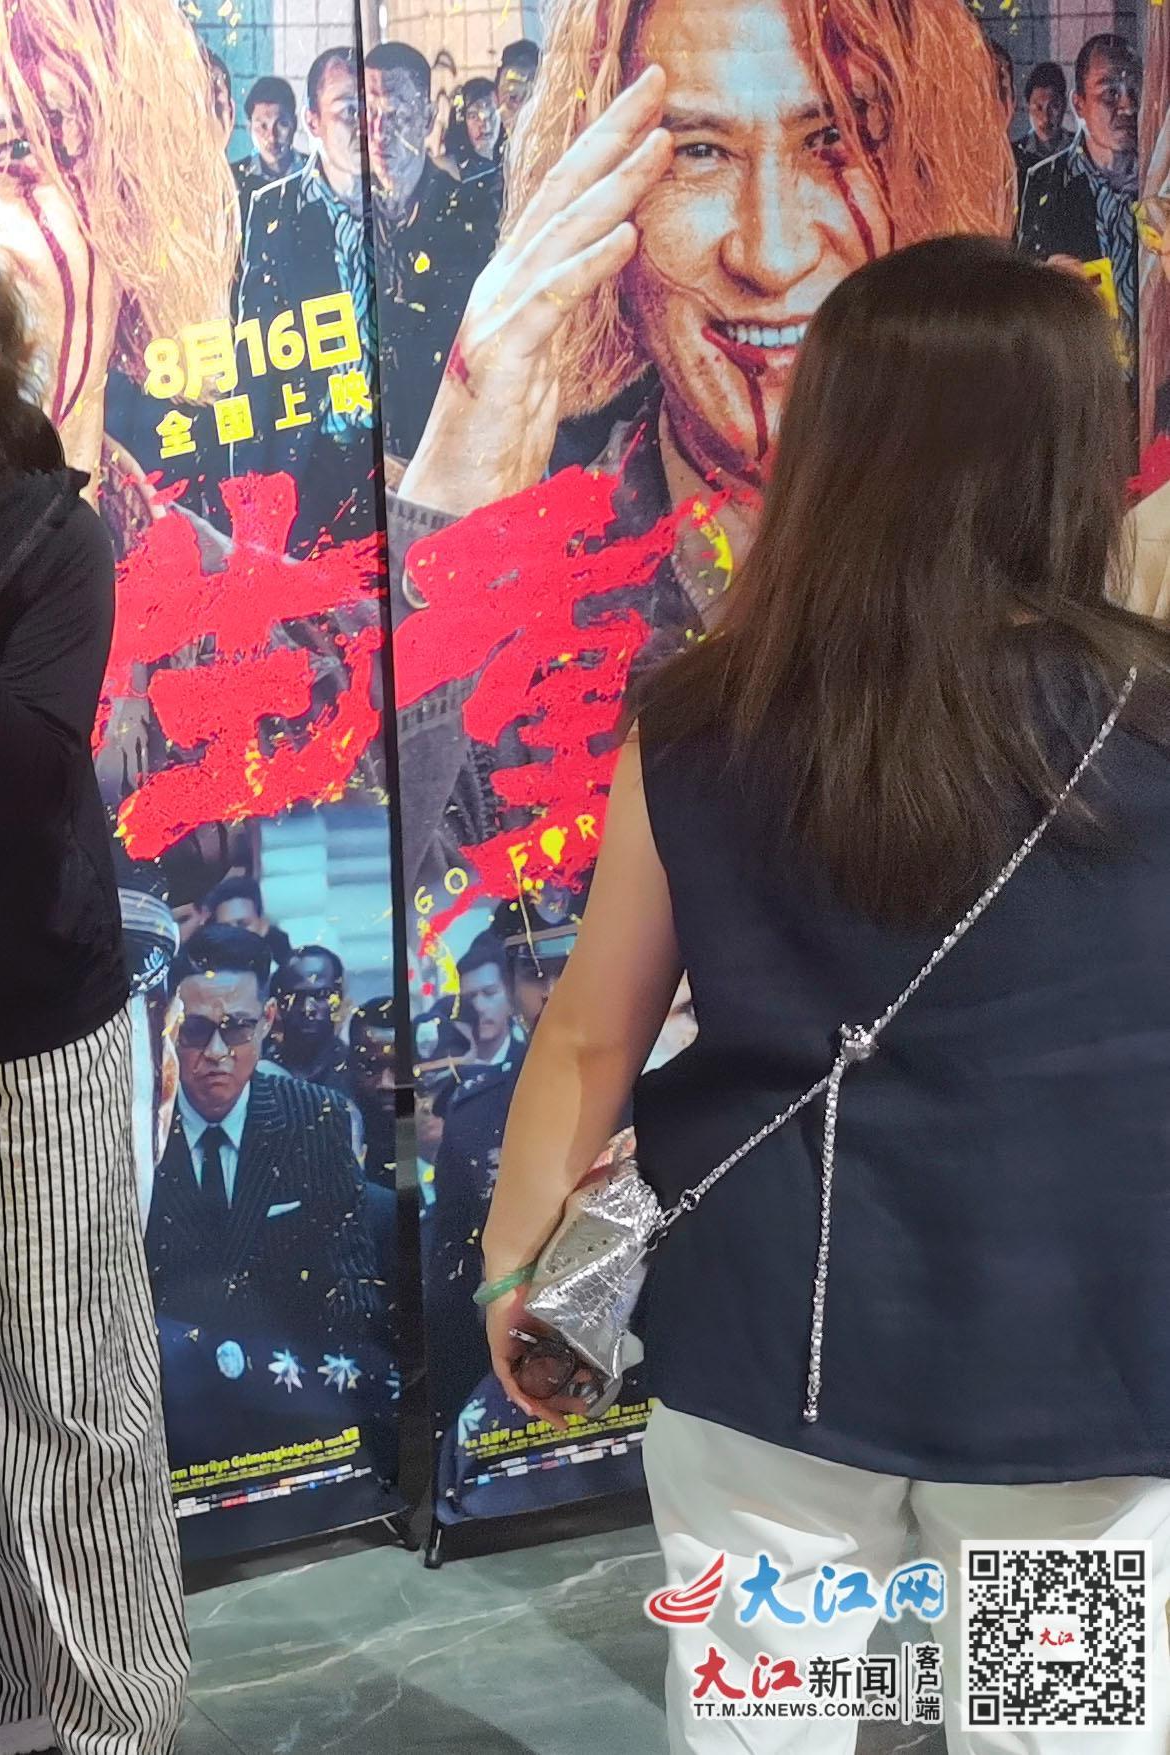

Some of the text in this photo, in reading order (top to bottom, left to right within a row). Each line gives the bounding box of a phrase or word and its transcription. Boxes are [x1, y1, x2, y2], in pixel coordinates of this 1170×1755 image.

[144, 291, 362, 400] 8月16日
[155, 368, 373, 459] 全国上映
